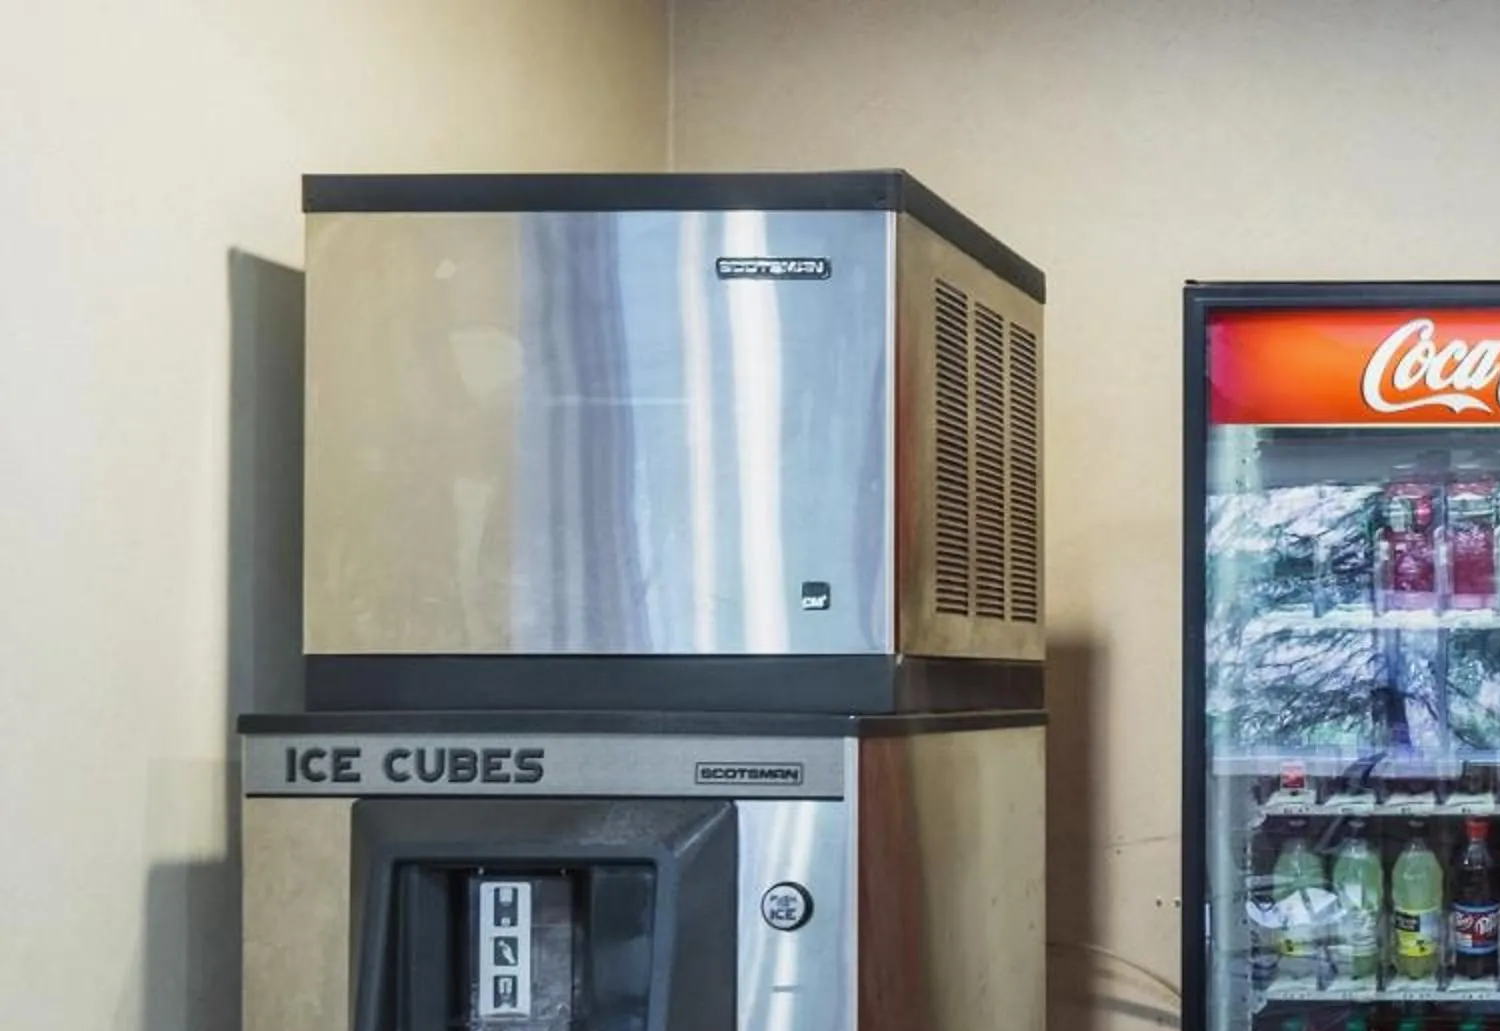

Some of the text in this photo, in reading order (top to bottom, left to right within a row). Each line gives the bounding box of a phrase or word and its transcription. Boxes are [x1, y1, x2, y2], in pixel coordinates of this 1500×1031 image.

[285, 746, 545, 784] ICE CUBES
[700, 767, 799, 781] SCOTSMAN
[769, 908, 797, 921] ICE
